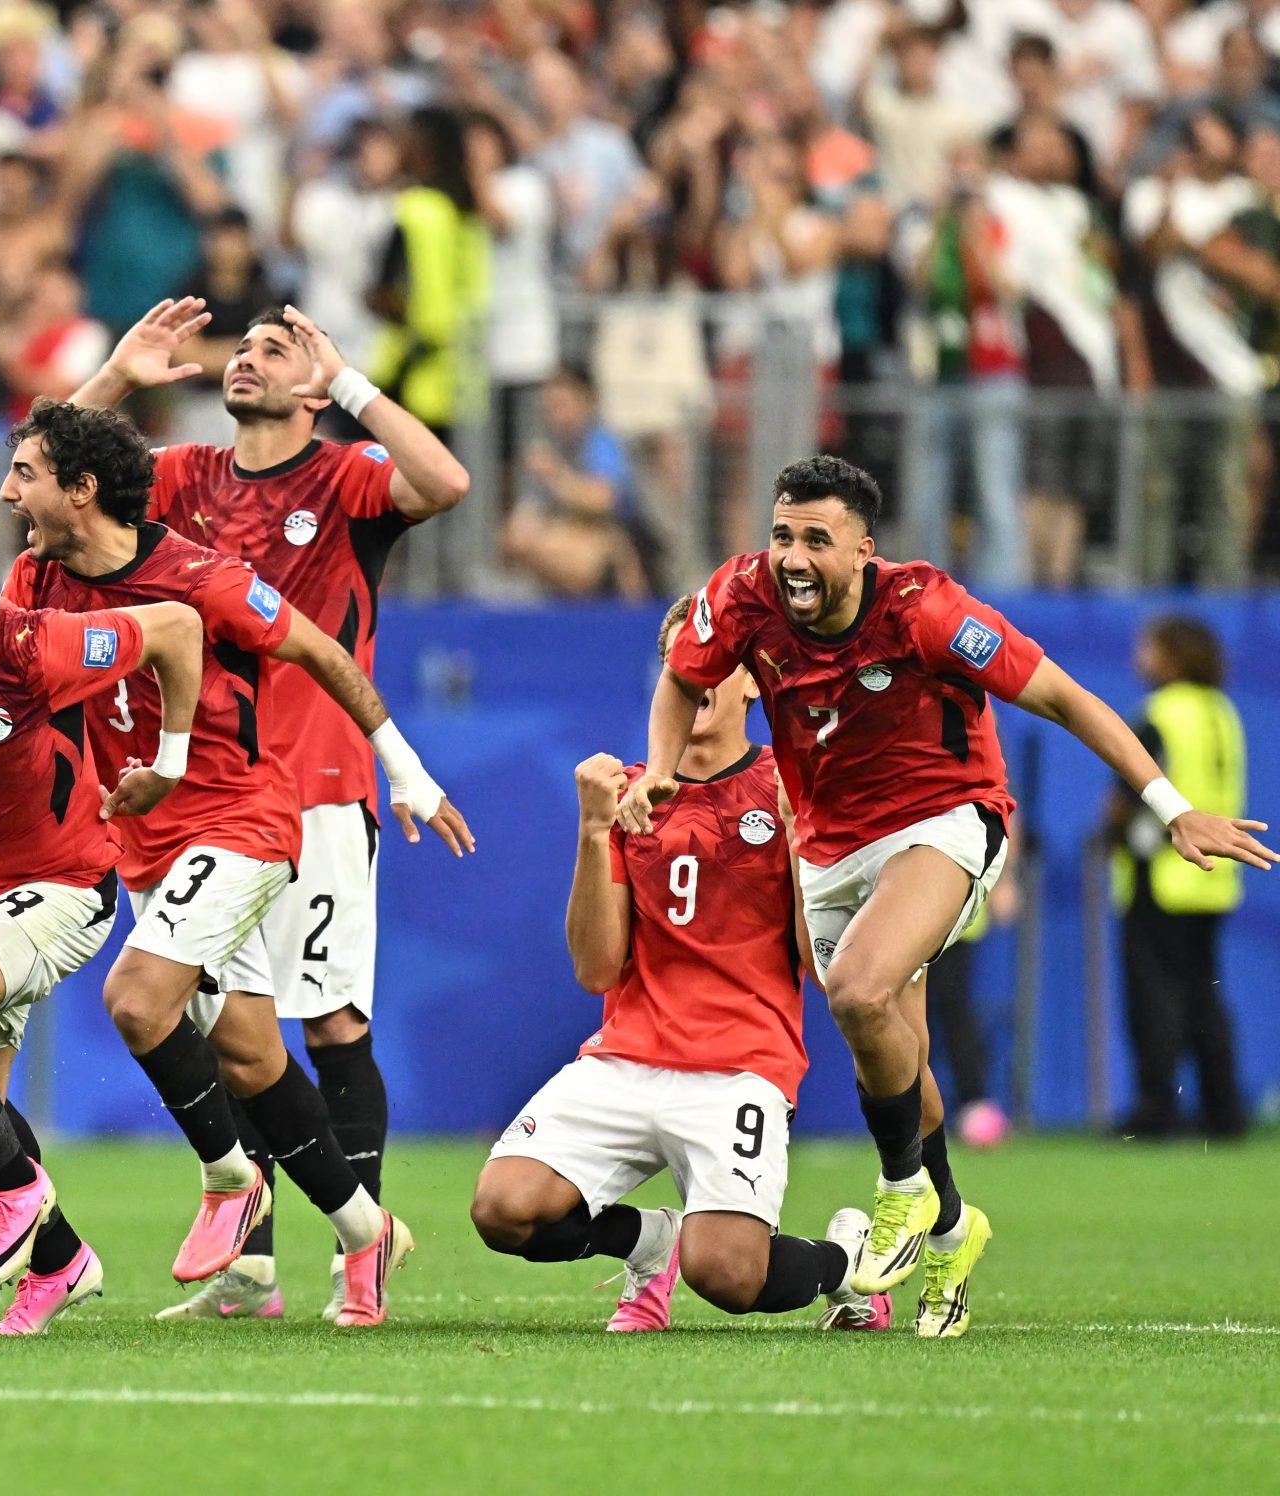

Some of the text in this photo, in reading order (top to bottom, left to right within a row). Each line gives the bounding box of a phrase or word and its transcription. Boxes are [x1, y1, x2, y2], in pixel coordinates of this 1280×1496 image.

[963, 628, 983, 654] UNITES
[108, 678, 135, 733] 3
[808, 705, 839, 747] 7
[166, 854, 217, 906] 3
[667, 855, 699, 926] 9
[302, 894, 335, 962] 2
[732, 1103, 765, 1160] 9
